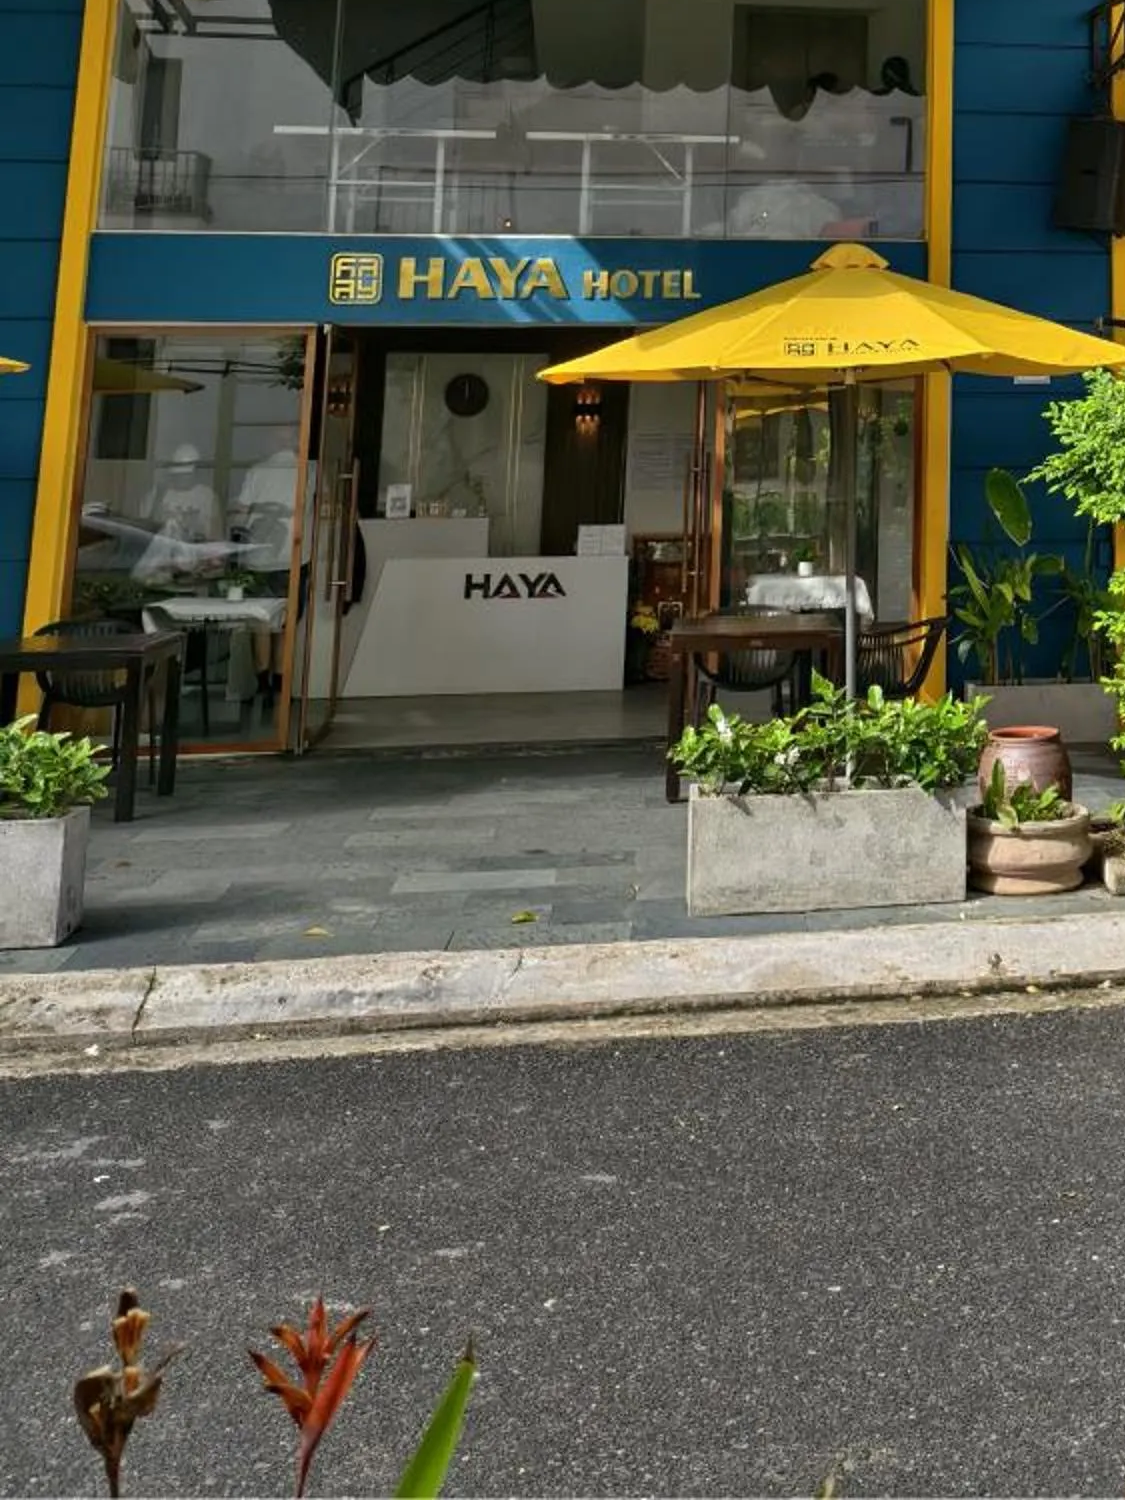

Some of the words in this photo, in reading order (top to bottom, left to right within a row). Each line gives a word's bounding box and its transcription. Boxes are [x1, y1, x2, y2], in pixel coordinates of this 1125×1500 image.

[398, 257, 568, 300] HAYA
[583, 269, 702, 300] HOTEL
[827, 339, 920, 357] HAYA
[464, 572, 567, 600] HAYA
